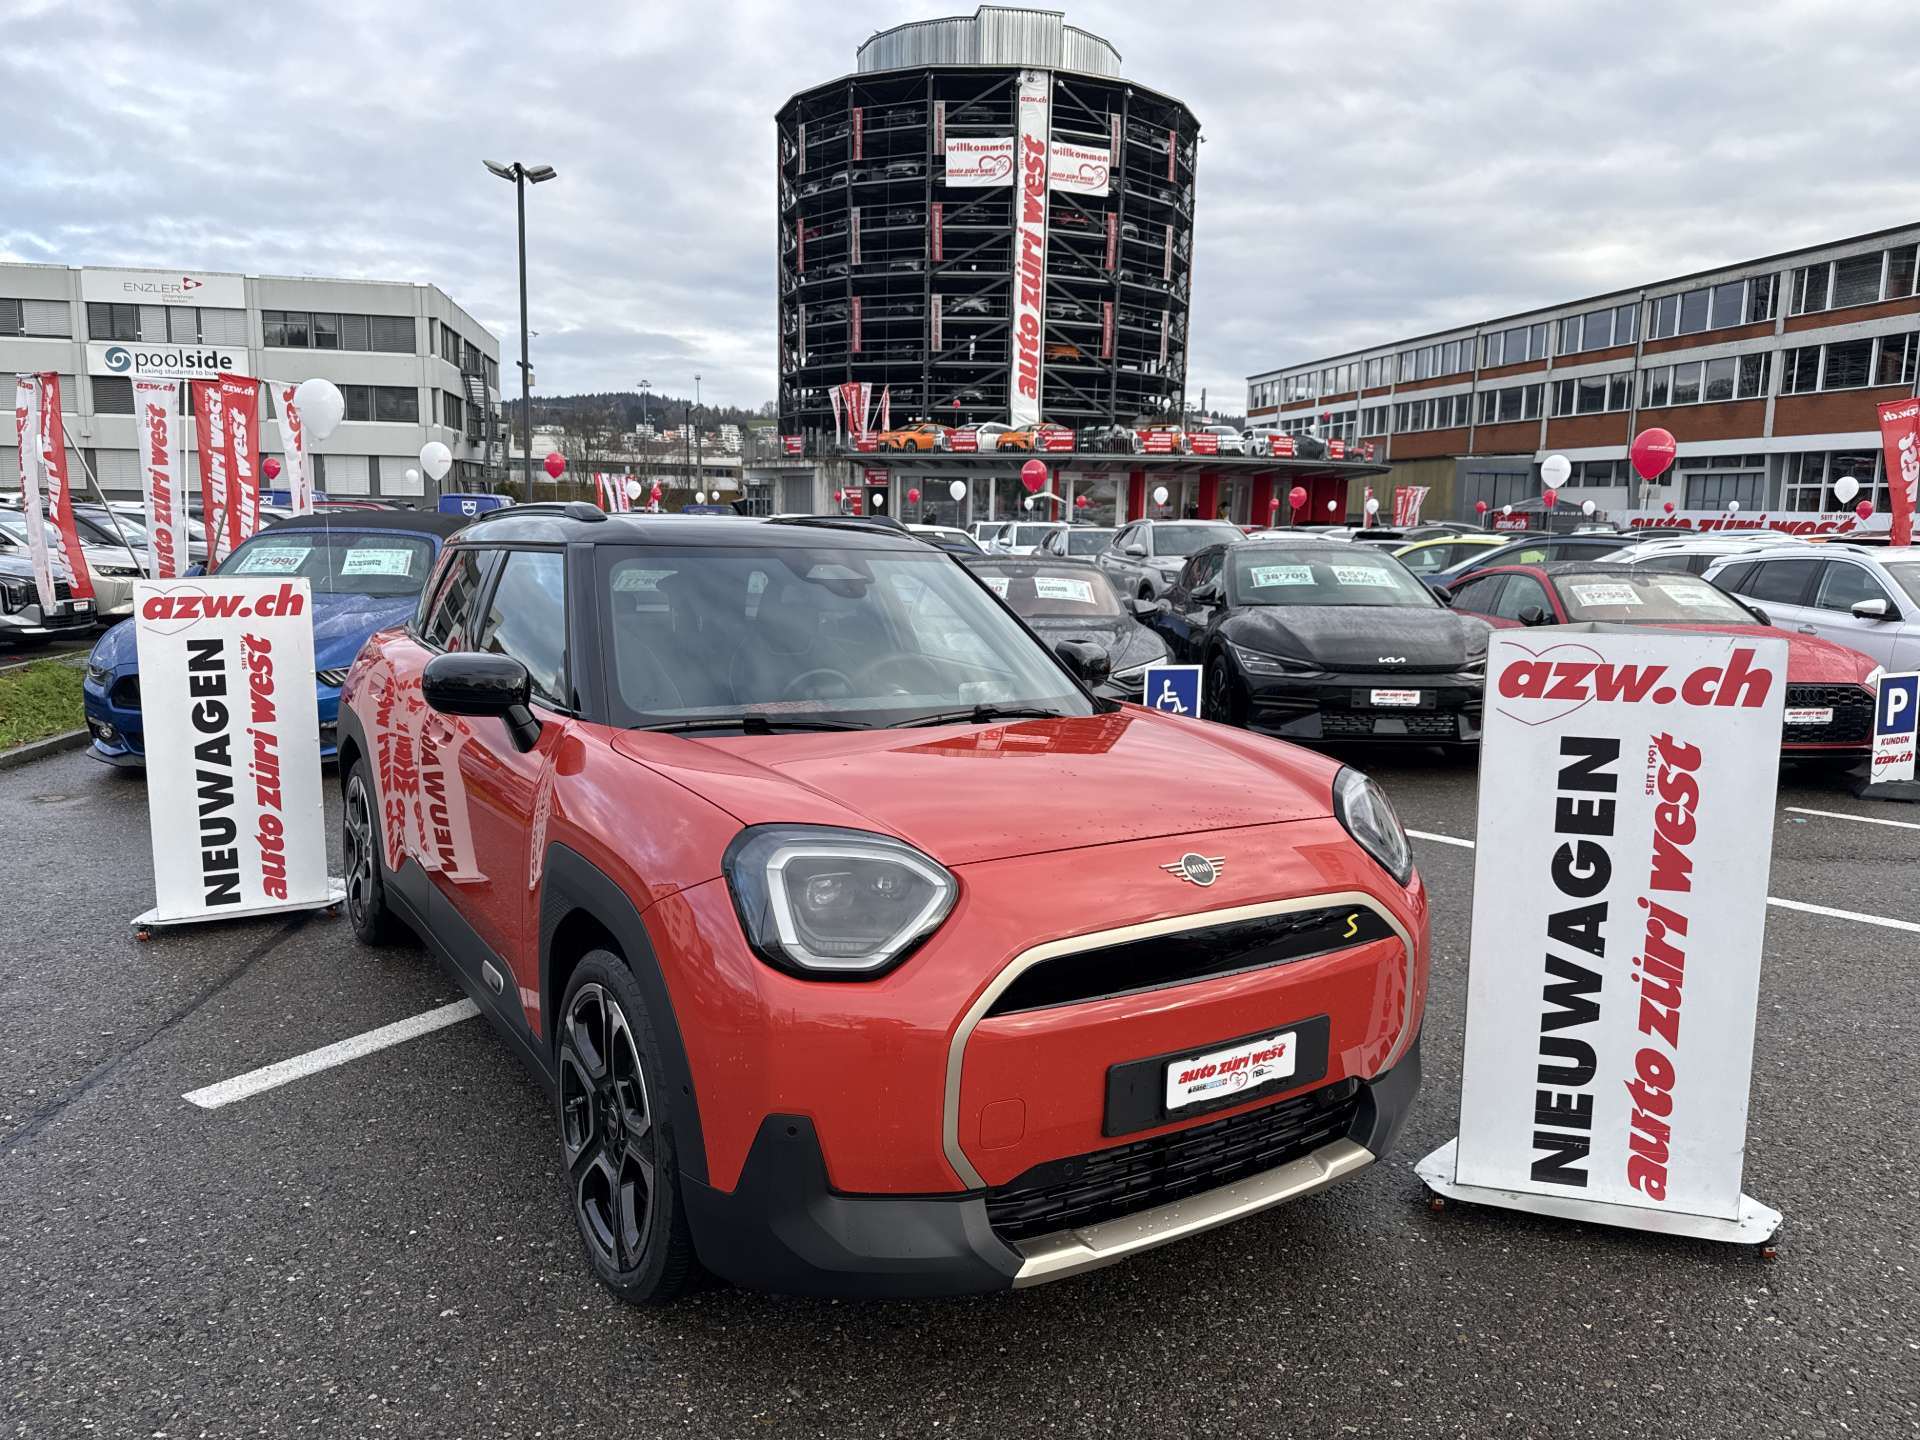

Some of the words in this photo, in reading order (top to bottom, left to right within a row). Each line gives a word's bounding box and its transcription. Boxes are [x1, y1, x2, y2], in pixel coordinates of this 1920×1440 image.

[1020, 95, 1047, 104] azw.ch
[947, 142, 1012, 152] willkommen
[1052, 147, 1108, 162] willkommen
[1023, 133, 1045, 223] west
[123, 282, 182, 294] ENZLER
[1017, 226, 1042, 313] züri
[134, 349, 233, 373] poolside
[141, 367, 163, 376] taking
[164, 368, 194, 376] students
[1016, 313, 1039, 400] auto
[136, 382, 176, 392] azw.ch
[221, 383, 255, 396] azw.ch
[146, 402, 169, 466] west
[229, 407, 252, 477] west
[148, 467, 172, 527] züri
[143, 583, 304, 621] azw.ch
[240, 632, 276, 724] west
[1498, 648, 1773, 708] azw.ch
[1886, 687, 1908, 727] P
[1647, 744, 1657, 769] 1991
[1874, 750, 1913, 765] azw.ch
[1880, 736, 1910, 746] KUNDEN
[186, 638, 241, 907] NEUWAGEN
[246, 727, 282, 812] züri
[1645, 774, 1655, 796] SEIT
[1650, 731, 1702, 893] west
[253, 813, 288, 900] auto
[1186, 862, 1212, 875] MINI
[1342, 913, 1359, 938] S
[1530, 735, 1621, 1188] NEUWAGEN
[1631, 896, 1689, 1051] züri
[1178, 1063, 1217, 1085] auto
[1217, 1052, 1251, 1075] züri
[1251, 1042, 1287, 1064] west
[1623, 1048, 1676, 1201] auto
